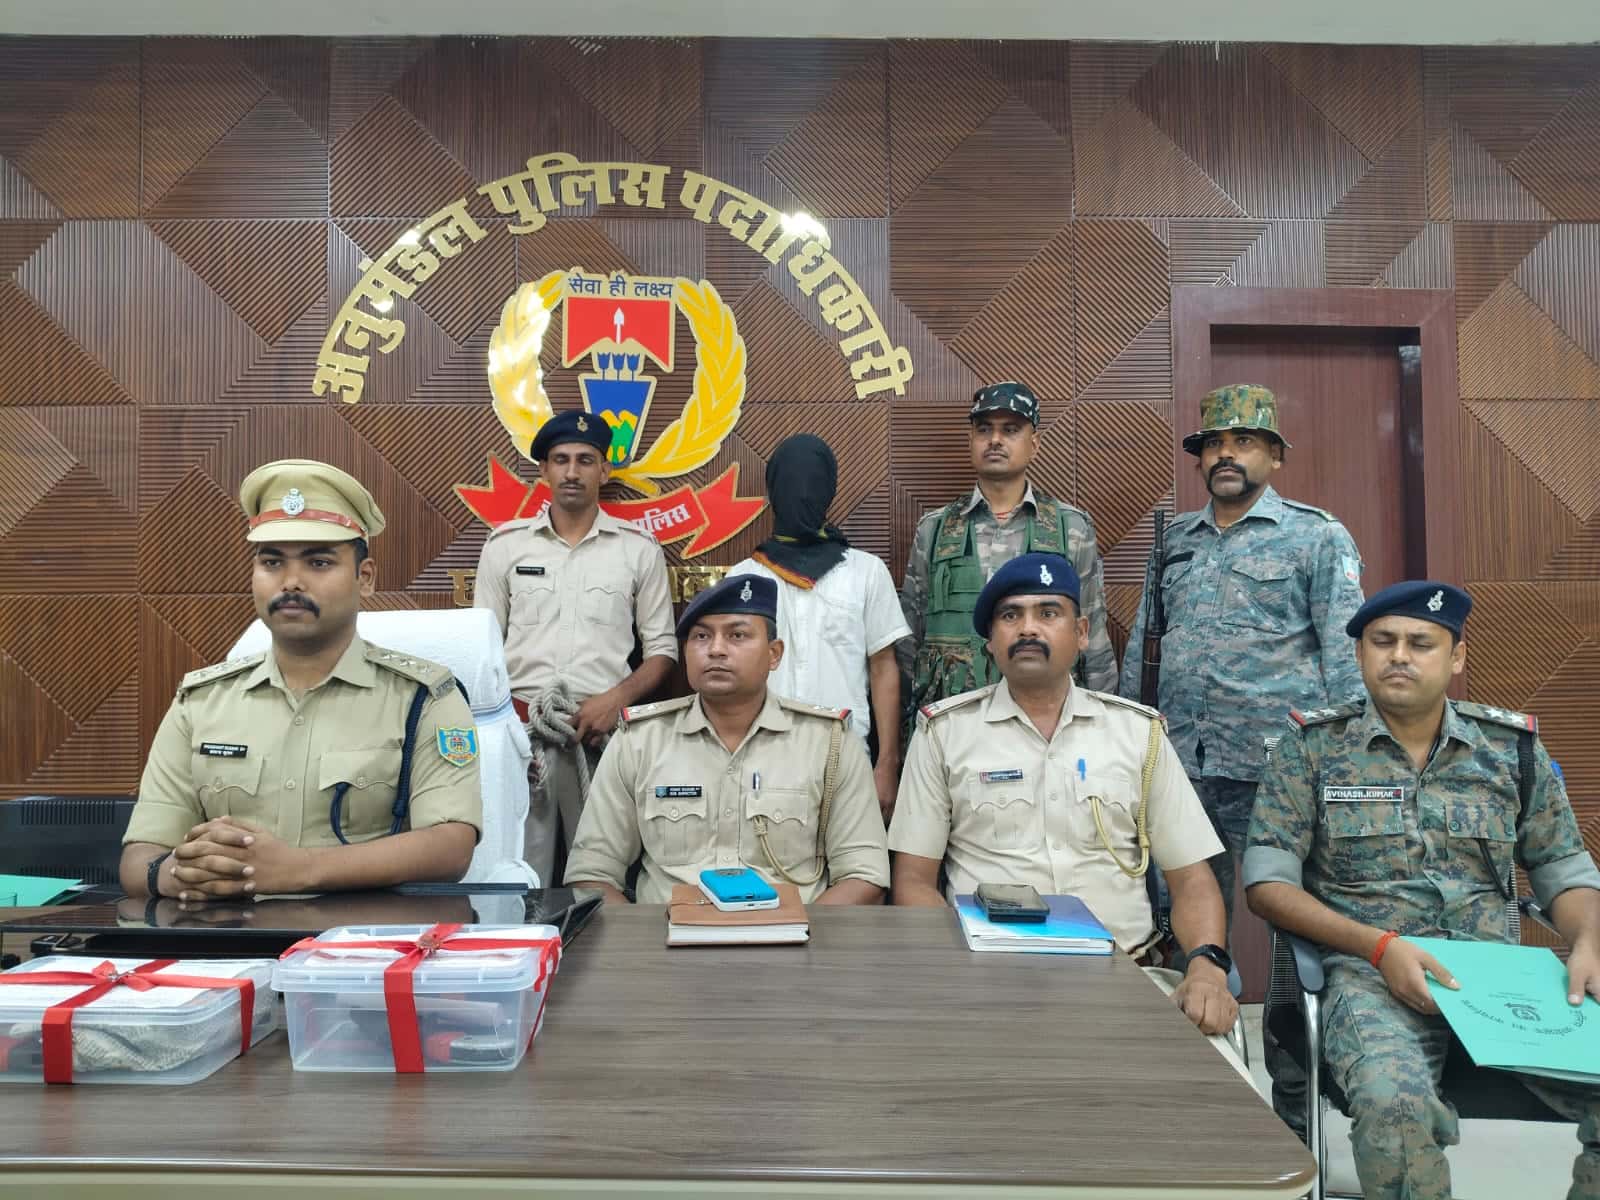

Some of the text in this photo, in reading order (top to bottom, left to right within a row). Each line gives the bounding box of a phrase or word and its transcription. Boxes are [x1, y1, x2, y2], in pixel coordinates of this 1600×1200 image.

[312, 151, 914, 404] अनुमंडल पुलिस पदाधिकारी
[568, 272, 674, 299] सेवा ही लक्ष्य
